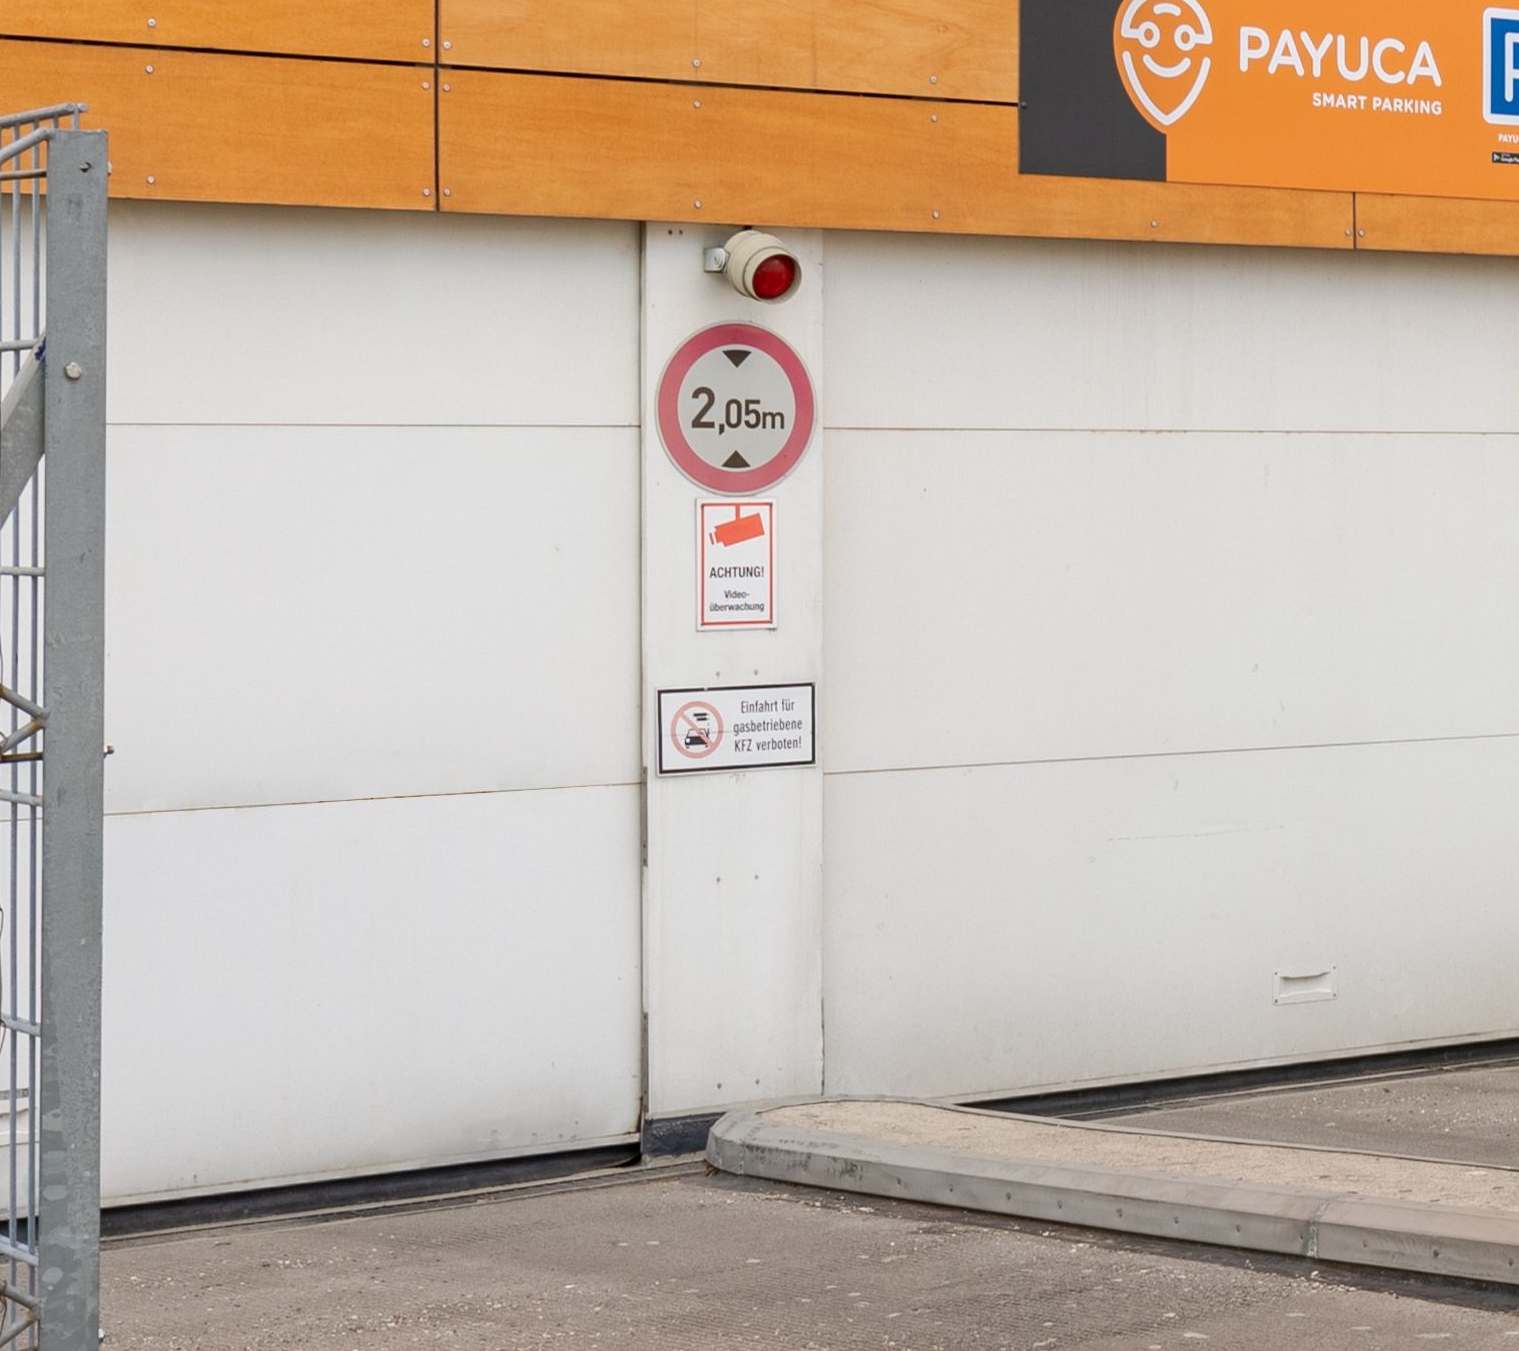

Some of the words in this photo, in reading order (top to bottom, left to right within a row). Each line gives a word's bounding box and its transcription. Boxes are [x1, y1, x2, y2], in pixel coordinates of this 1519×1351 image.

[1239, 25, 1442, 87] PAYUCA
[1312, 92, 1367, 109] SMART
[1372, 97, 1442, 115] PARKING
[691, 386, 785, 436] 2,05m
[709, 566, 765, 578] ACHTUNG!
[724, 589, 750, 599] Video-
[709, 602, 765, 612] überwachung
[741, 700, 778, 713] Einfahrt
[782, 698, 795, 711] für
[733, 718, 803, 736] gasbetriebene
[734, 739, 752, 753] KFZ
[756, 736, 802, 751] verboten!
